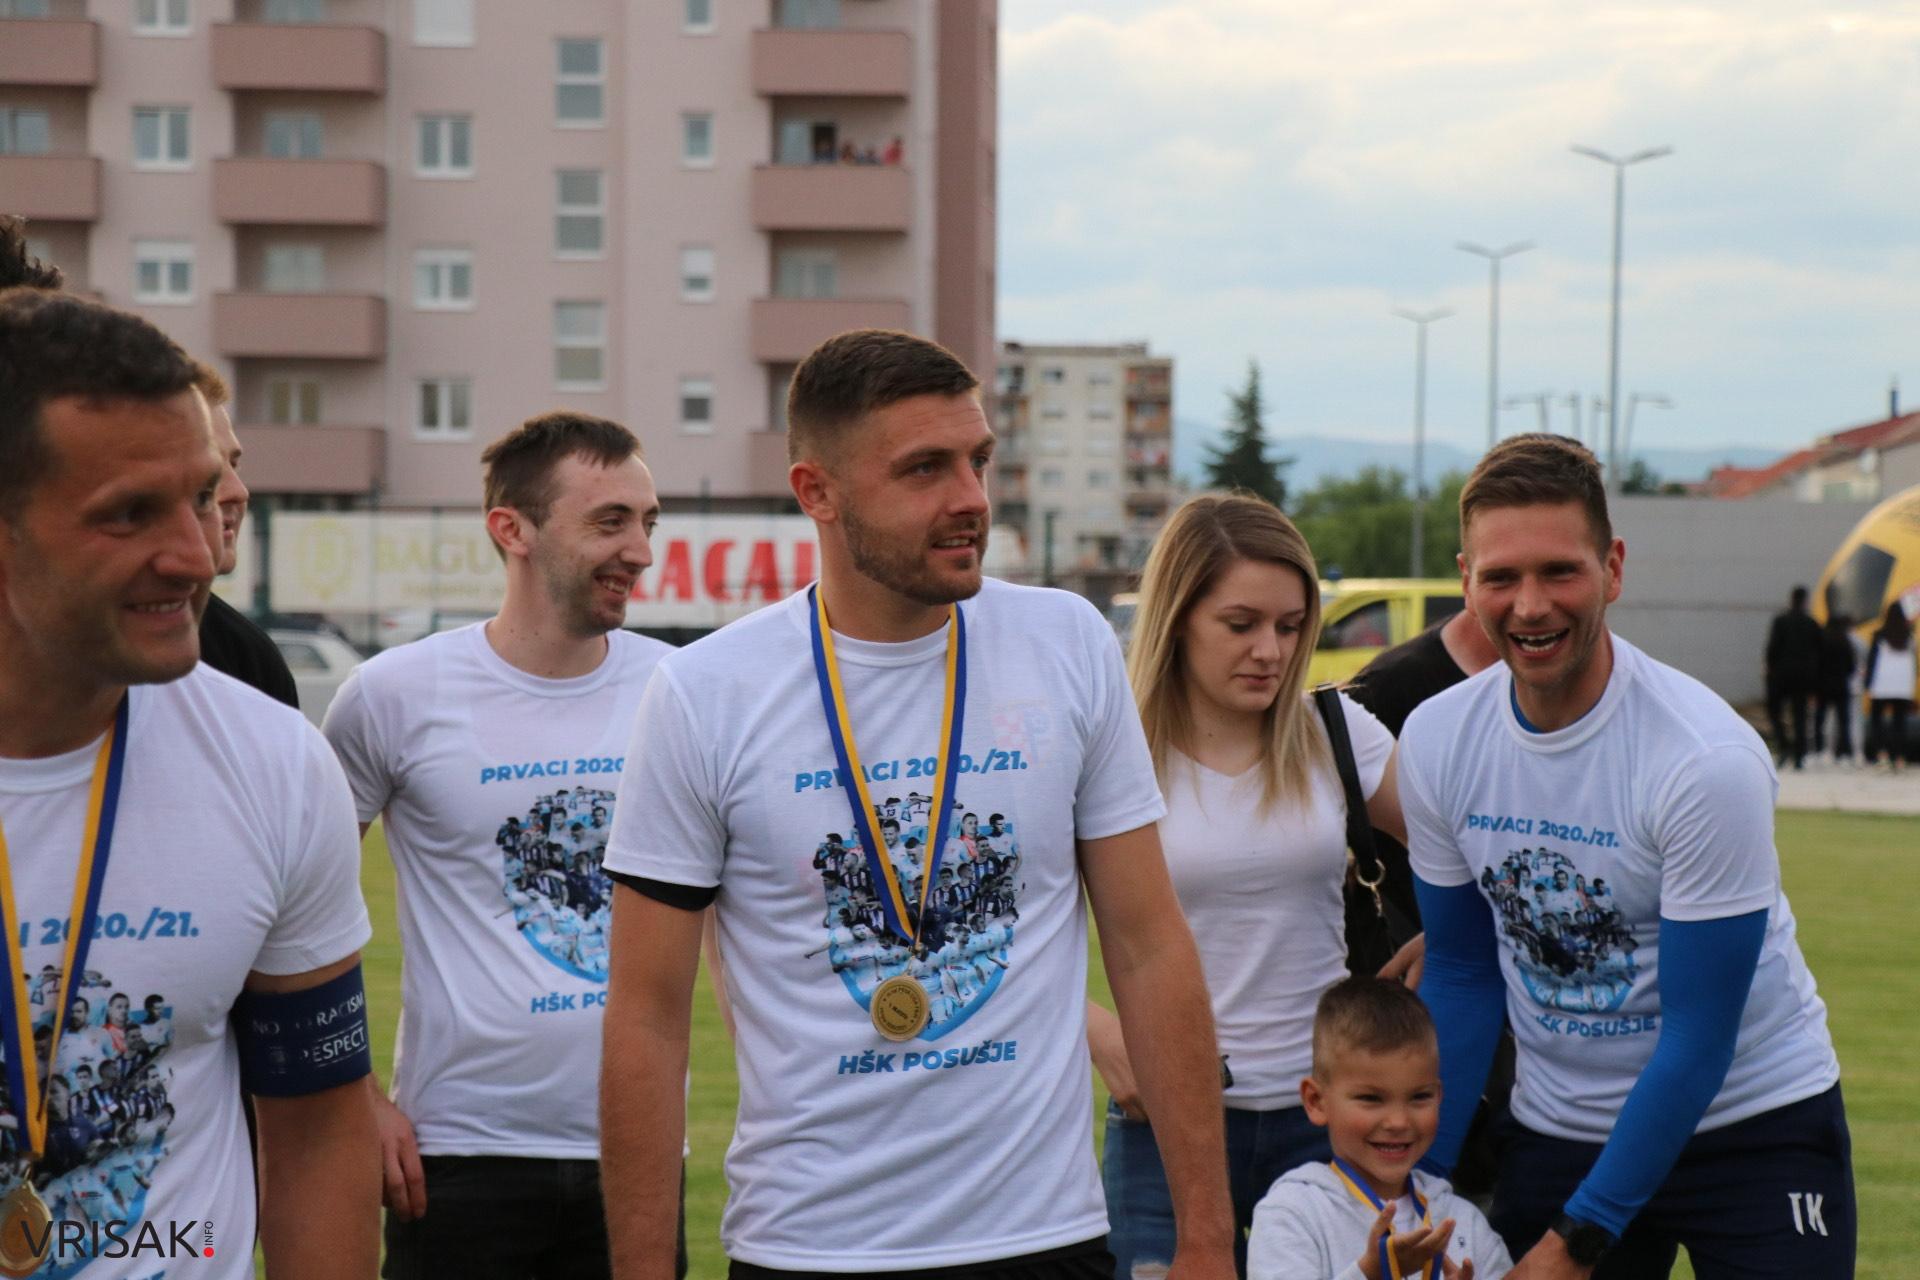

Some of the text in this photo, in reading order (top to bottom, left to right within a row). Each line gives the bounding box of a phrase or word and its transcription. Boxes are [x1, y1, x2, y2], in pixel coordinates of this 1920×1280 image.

[480, 760, 569, 785] PRVACI
[794, 748, 1028, 793] PRVCI 200./21.
[1467, 814, 1620, 848] PRVACI 2020./21.
[40, 906, 199, 946] 20./21.
[531, 991, 577, 1014] HŠK
[303, 1026, 366, 1062] ESPECT
[838, 1039, 1017, 1075] HŠK POSUŠJE
[1787, 1192, 1829, 1237] TK
